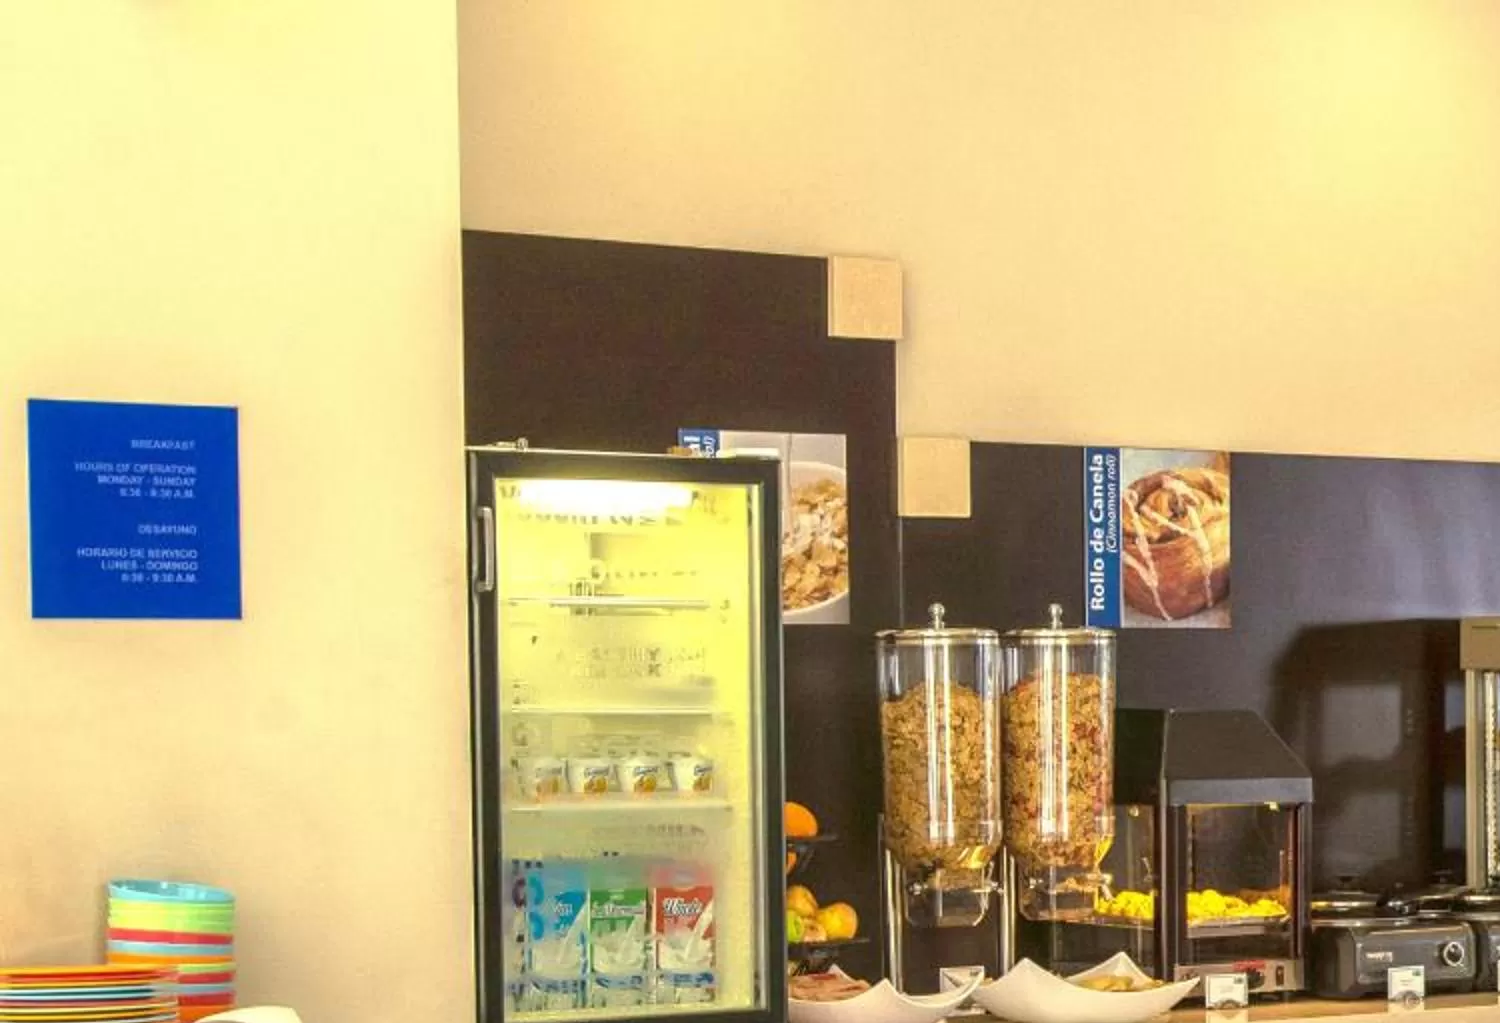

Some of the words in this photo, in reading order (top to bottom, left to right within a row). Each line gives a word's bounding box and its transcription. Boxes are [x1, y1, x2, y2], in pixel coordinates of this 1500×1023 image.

[131, 439, 196, 450] BREAKFAST
[75, 462, 113, 473] HOURS
[115, 463, 129, 473] OF
[133, 463, 197, 475] OPERATION
[97, 475, 144, 485] MONDAY
[153, 475, 198, 487] SUNDAY
[1089, 453, 1105, 522] Canela
[137, 523, 198, 535] DESAYUNO
[1090, 530, 1104, 553] de
[77, 547, 128, 558] HORARIO
[129, 547, 145, 558] DE
[147, 548, 199, 559] SERVICIO
[101, 559, 138, 571] LUNES
[146, 560, 199, 571] DOMINGO
[1090, 560, 1105, 611] Rollo
